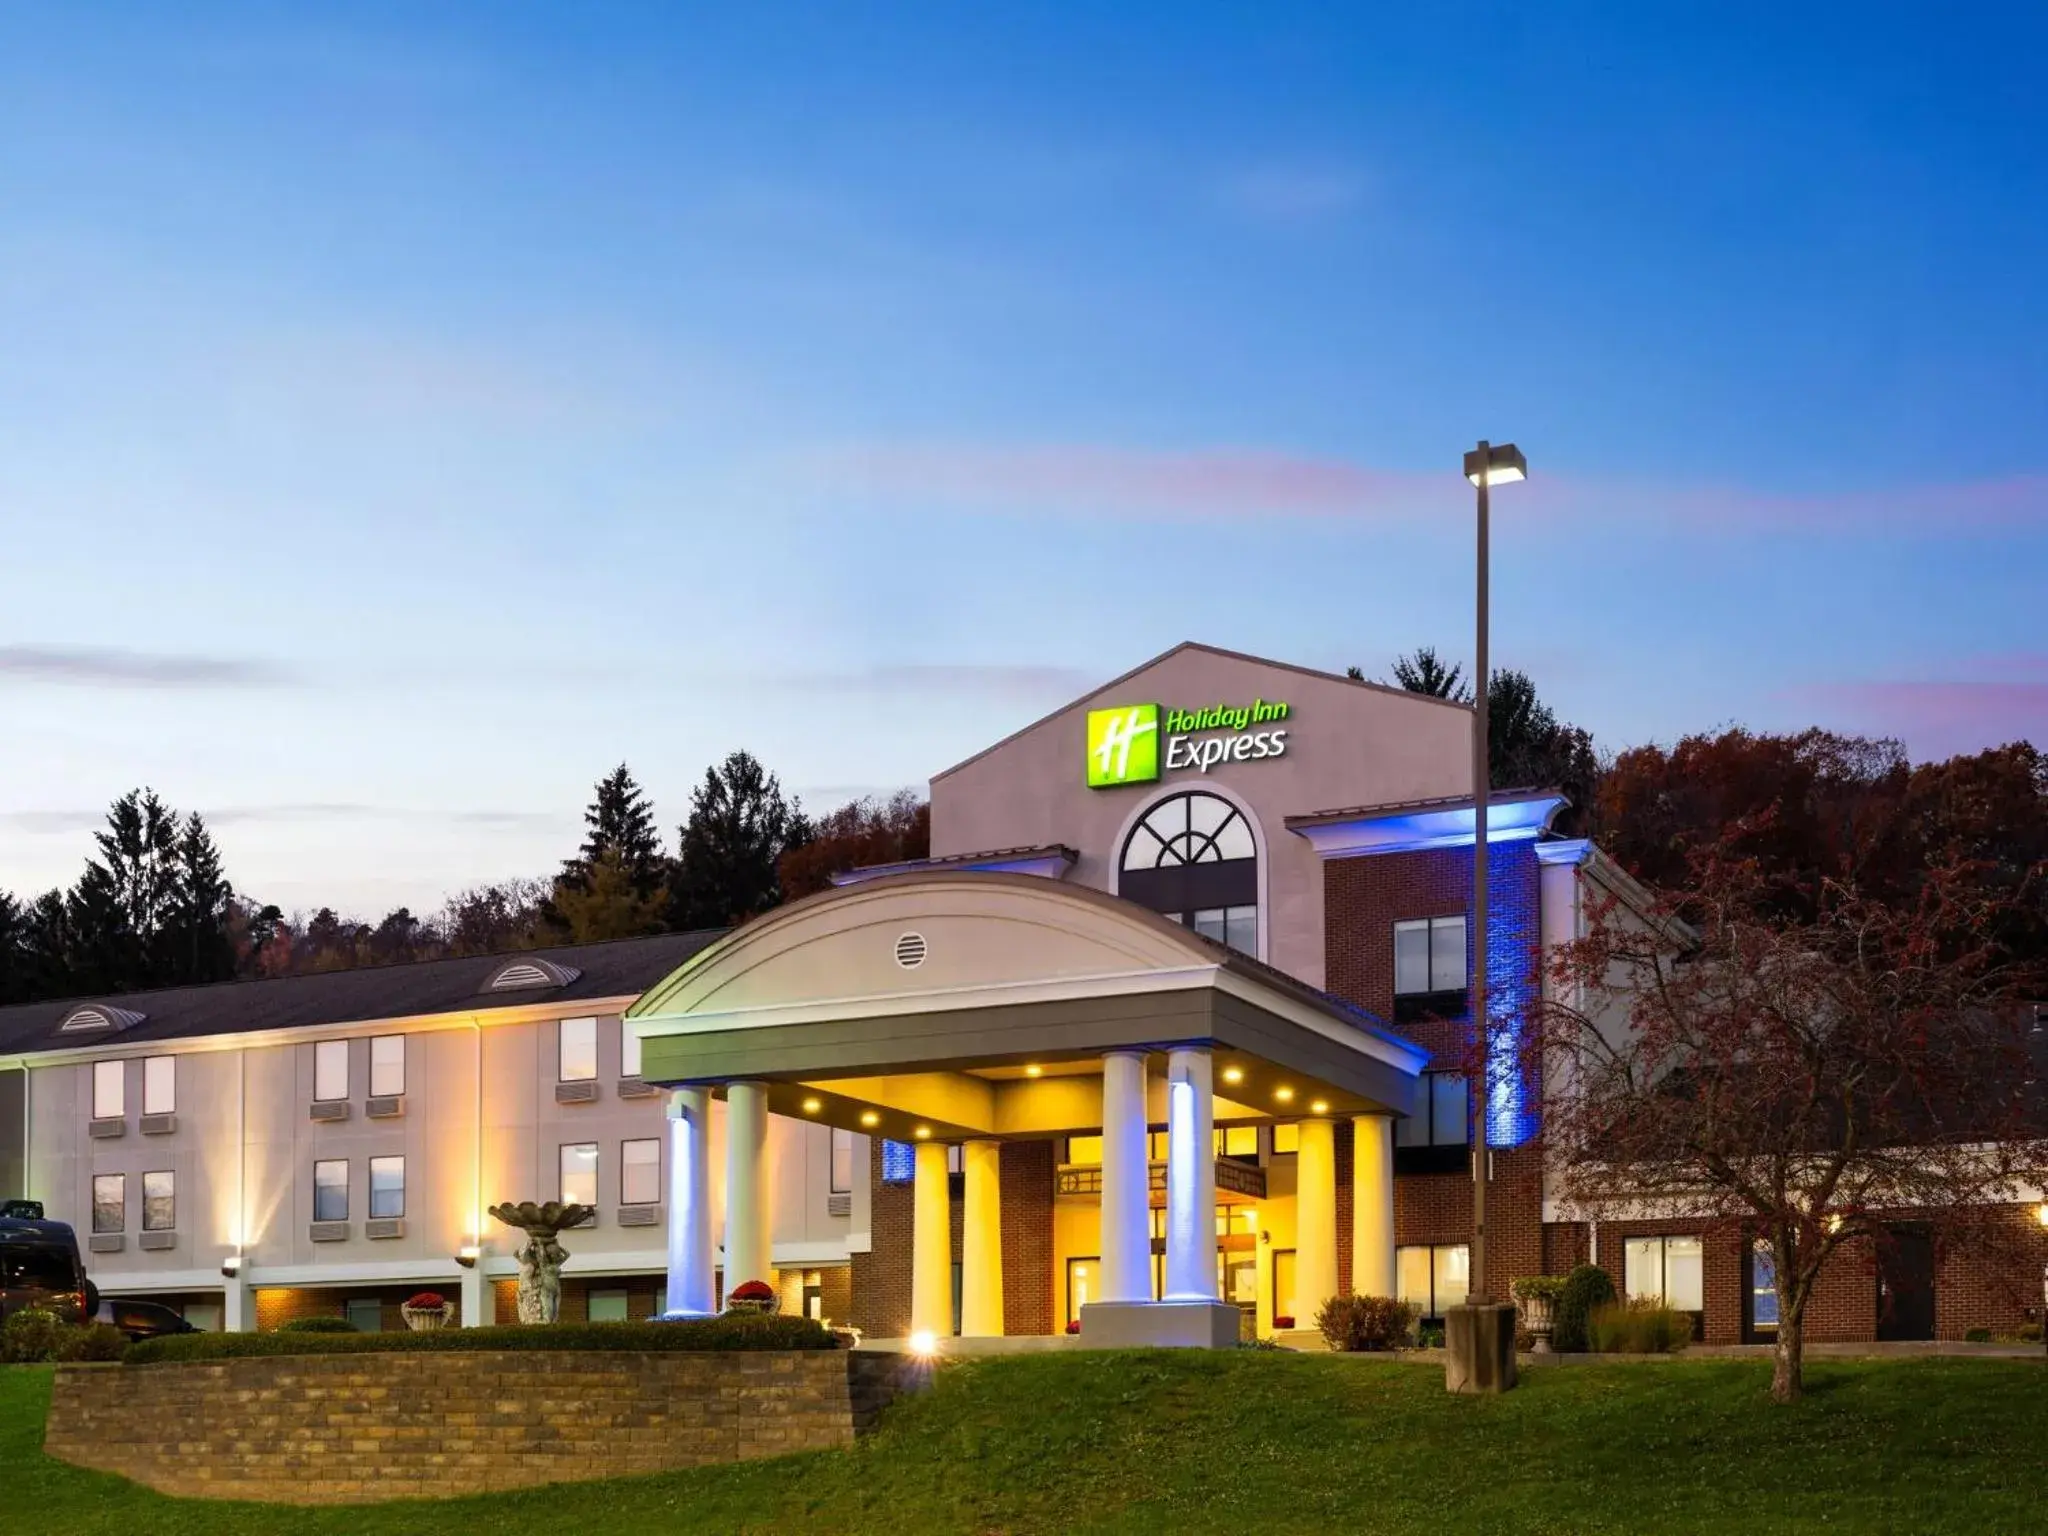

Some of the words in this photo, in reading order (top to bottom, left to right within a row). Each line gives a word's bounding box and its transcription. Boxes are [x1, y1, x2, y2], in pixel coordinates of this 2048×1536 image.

[1166, 703, 1249, 732] Holiday
[1253, 699, 1288, 722] Inn
[1166, 729, 1286, 773] Express
